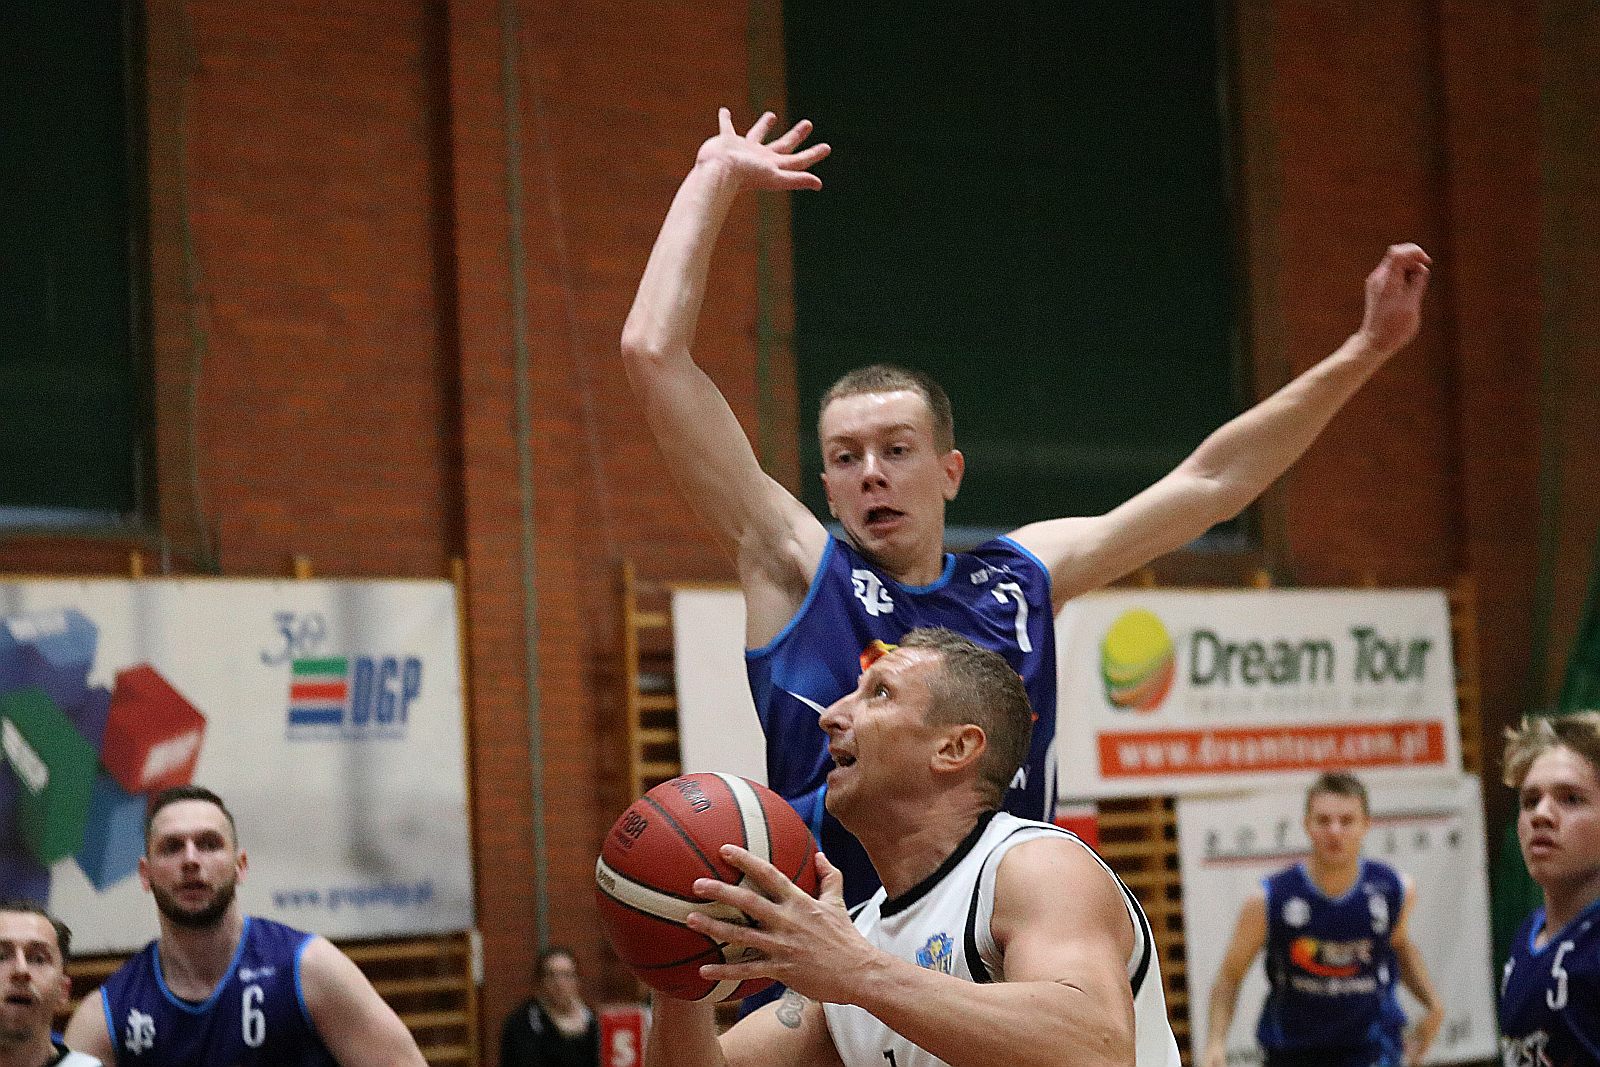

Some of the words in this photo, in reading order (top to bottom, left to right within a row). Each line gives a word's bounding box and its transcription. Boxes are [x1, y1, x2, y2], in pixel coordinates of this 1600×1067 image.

[990, 581, 1033, 653] 7
[350, 655, 423, 726] DGP
[1190, 628, 1336, 687] Dream
[1348, 625, 1433, 684] Tour
[1546, 939, 1576, 1011] 5
[241, 984, 266, 1048] 6
